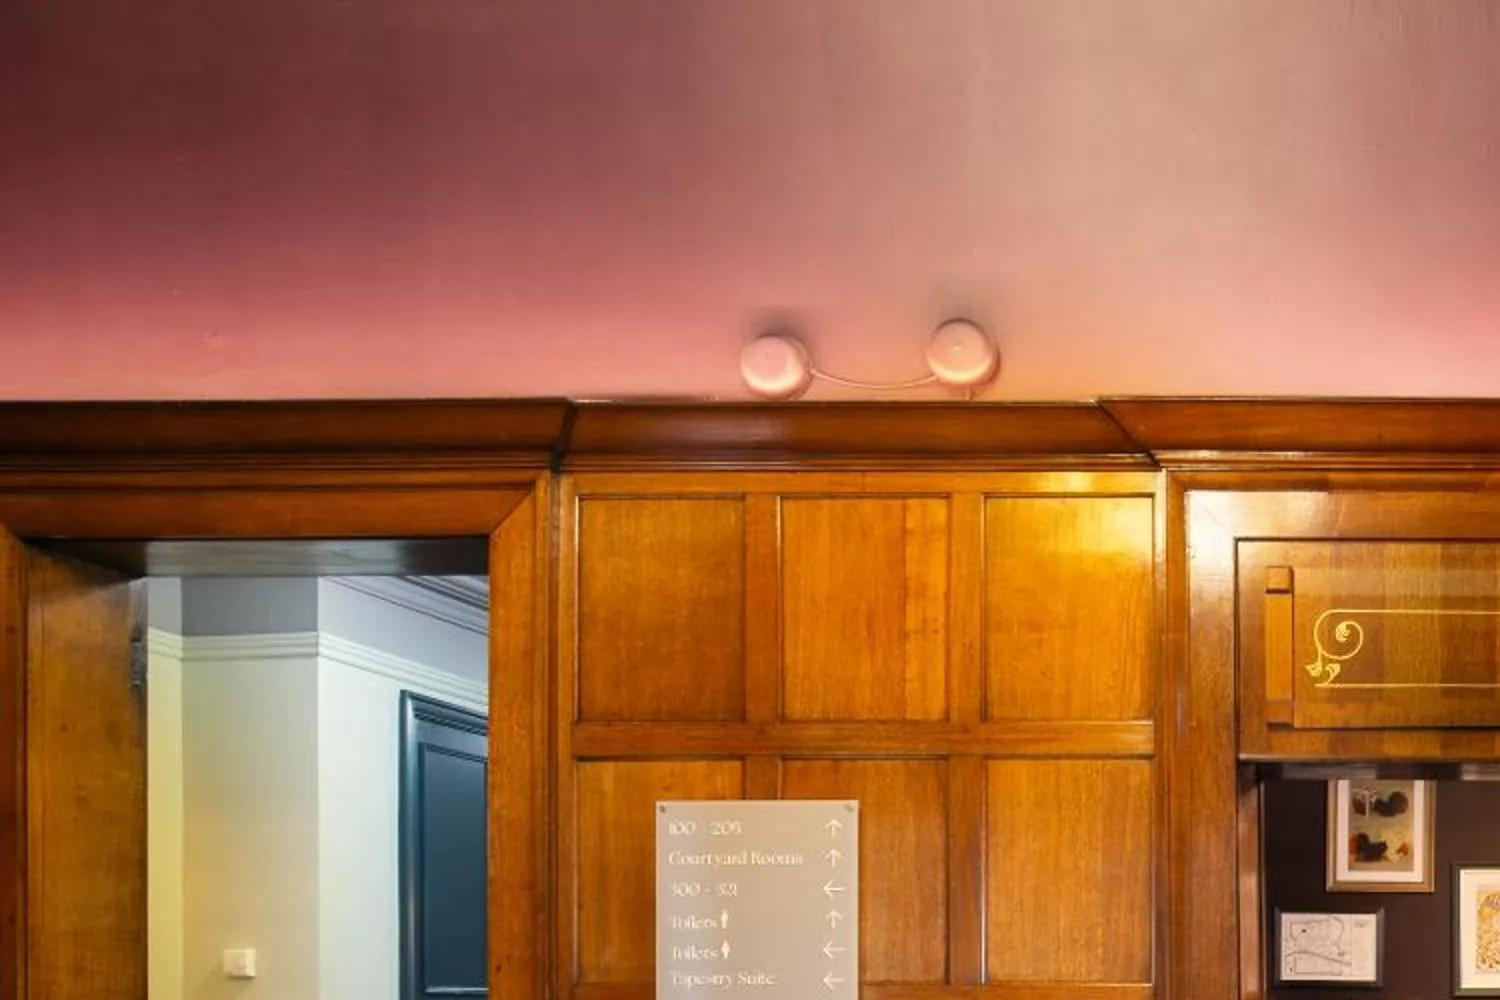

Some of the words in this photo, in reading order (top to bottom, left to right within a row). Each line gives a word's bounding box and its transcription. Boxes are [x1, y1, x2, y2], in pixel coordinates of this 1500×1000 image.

[668, 850, 747, 870] Courtyard
[751, 850, 804, 866] Rooms
[670, 914, 718, 930] Toilets
[670, 945, 718, 961] Toilets
[669, 970, 732, 990] Tapestry
[737, 970, 778, 986] Suite
